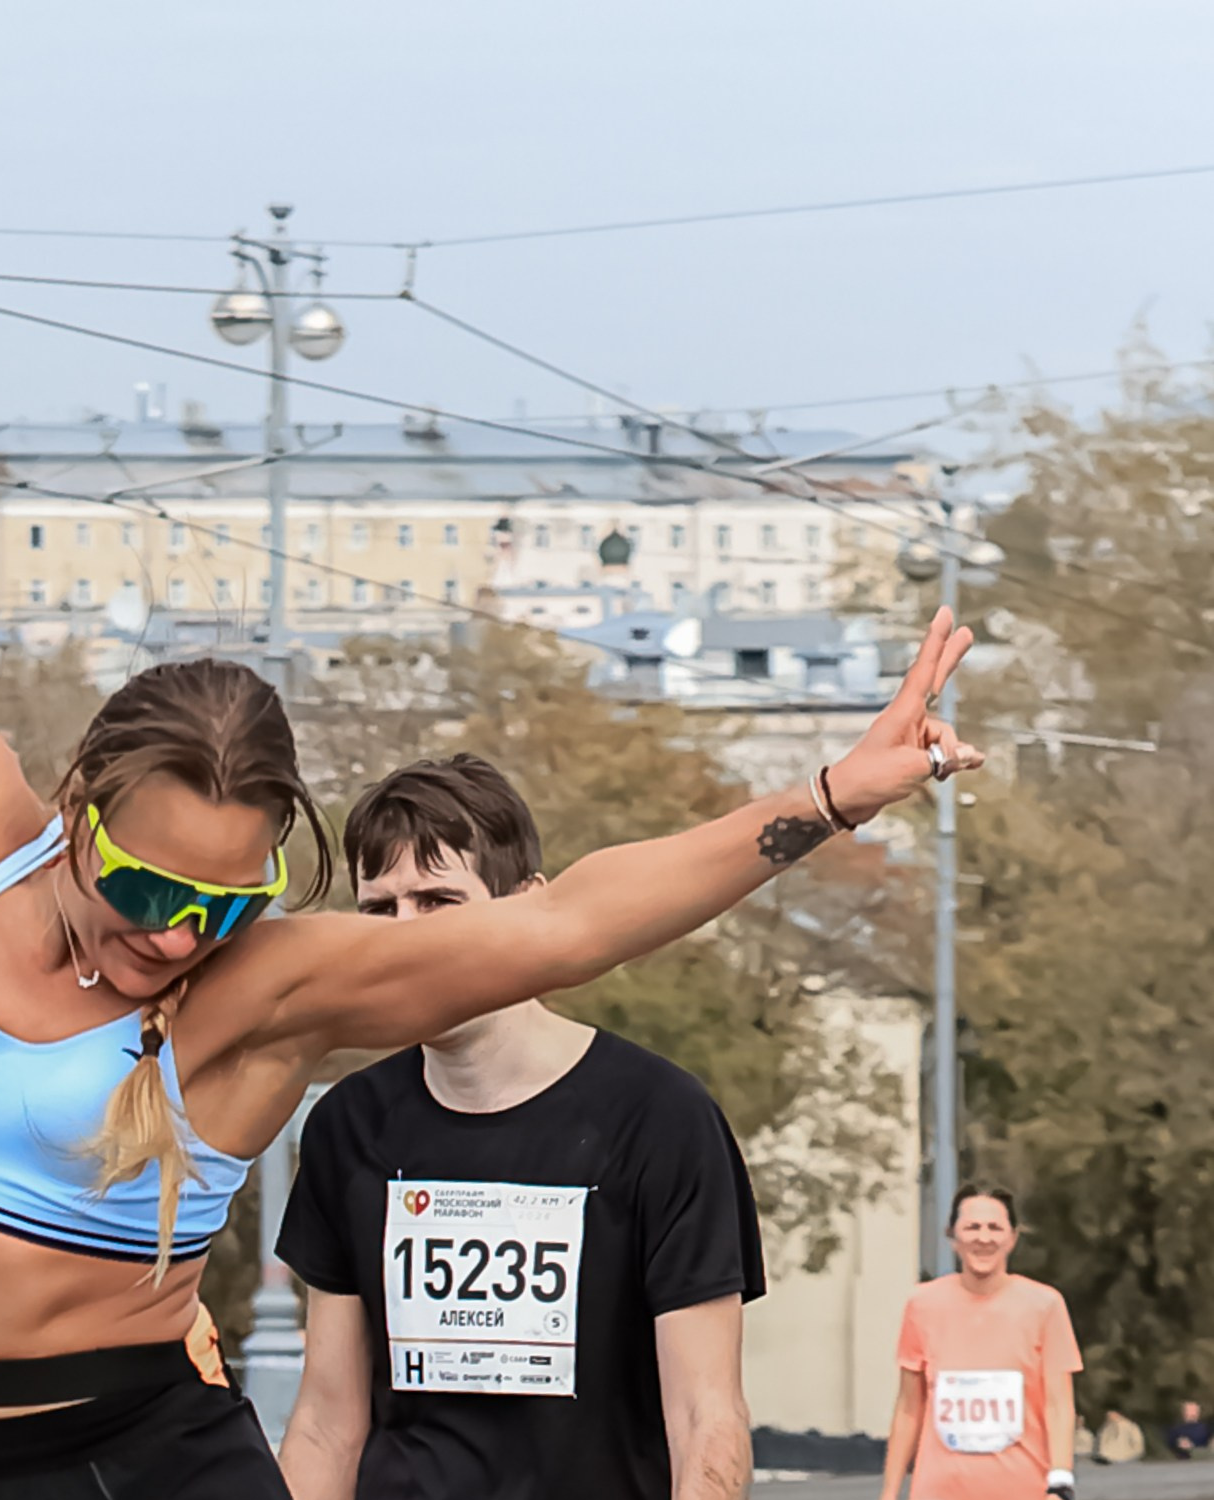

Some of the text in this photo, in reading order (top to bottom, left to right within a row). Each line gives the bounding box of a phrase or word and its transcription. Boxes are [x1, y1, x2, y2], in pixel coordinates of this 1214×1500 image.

[434, 1197, 502, 1208] МОСКОВСКИЙ
[434, 1209, 483, 1218] МАРАФОН
[393, 1237, 569, 1304] 15235
[439, 1308, 505, 1328] АЛЕКСЕЙ
[939, 1397, 1016, 1423] 21011
